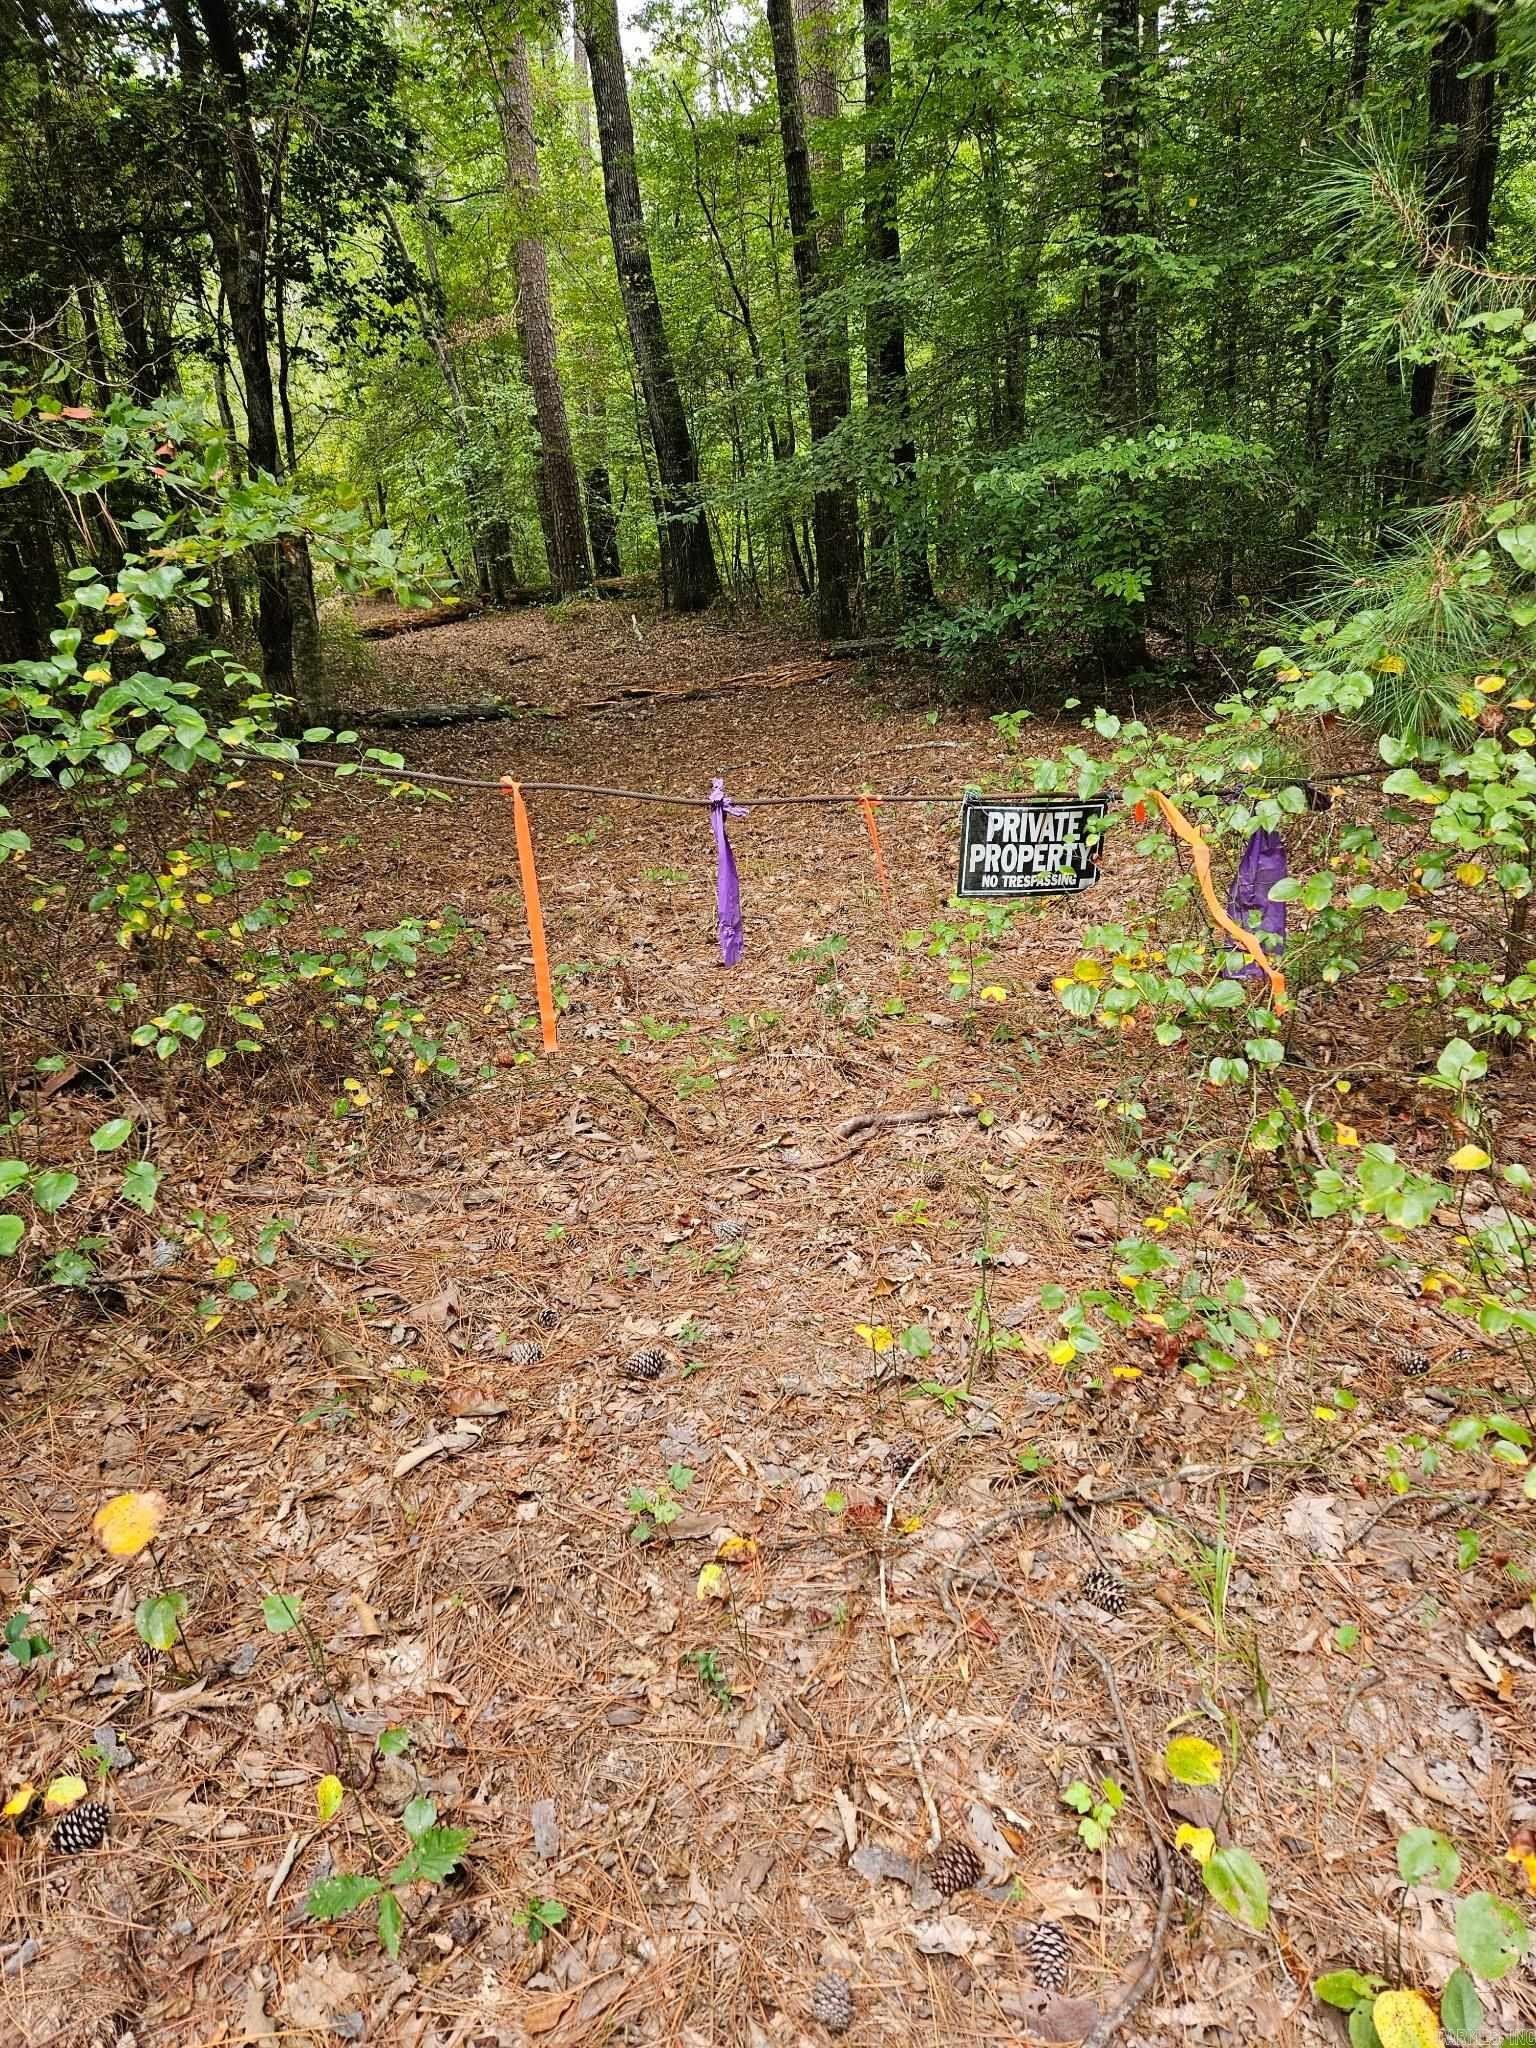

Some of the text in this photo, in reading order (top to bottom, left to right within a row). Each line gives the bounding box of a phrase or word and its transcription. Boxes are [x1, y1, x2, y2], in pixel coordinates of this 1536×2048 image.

[987, 811, 1083, 843] PRIVATE
[969, 843, 1091, 873] PROPERTY
[981, 875, 998, 888] NO
